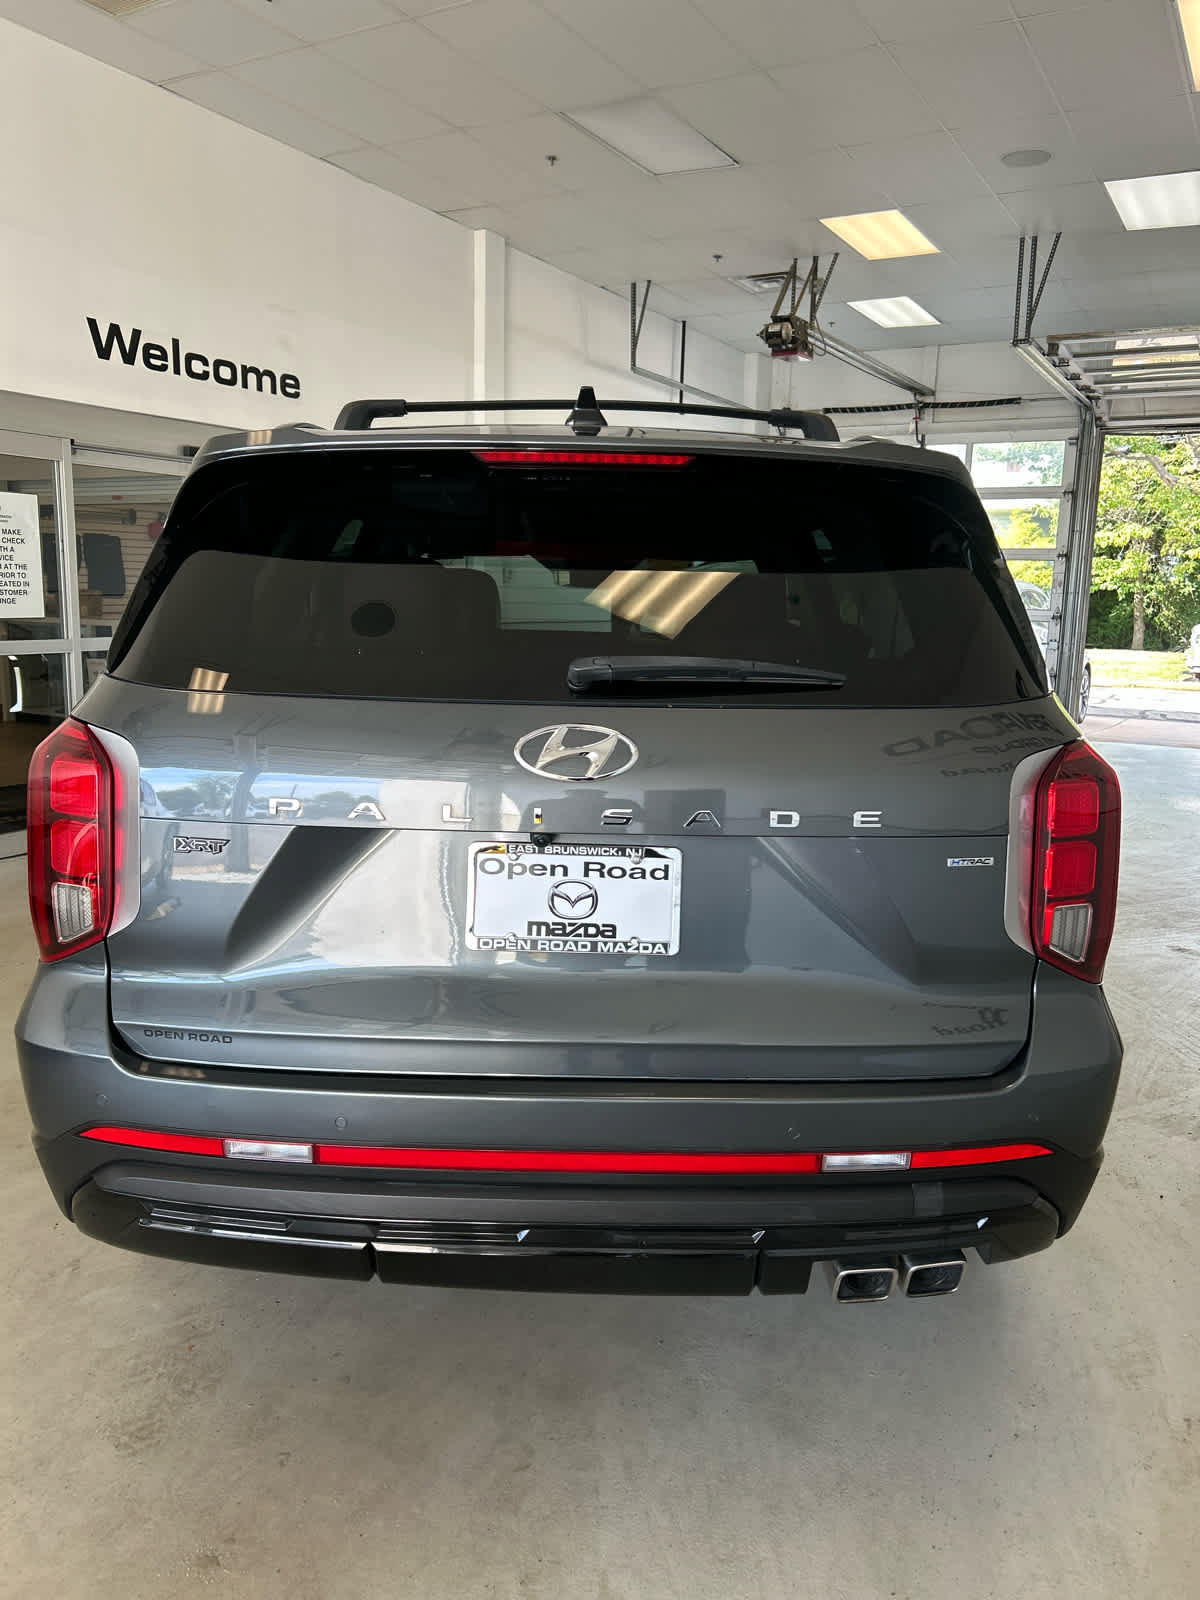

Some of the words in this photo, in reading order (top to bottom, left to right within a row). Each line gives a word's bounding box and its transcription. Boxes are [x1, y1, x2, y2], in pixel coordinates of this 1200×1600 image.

[86, 316, 301, 399] Welcome
[1, 528, 22, 536] MAKE
[1, 536, 26, 545] CHECK
[14, 563, 28, 571] THE
[23, 580, 30, 588] IN
[268, 797, 883, 828] PALISADE
[173, 836, 231, 855] XRT
[508, 845, 539, 854] EAST
[544, 846, 623, 856] BRUNSWICK,
[625, 847, 643, 857] NJ
[479, 857, 569, 880] Open
[583, 861, 670, 881] Road
[949, 857, 993, 866] HTRAC
[527, 921, 617, 939] mazda
[479, 938, 531, 951] OPEN
[537, 939, 591, 952] ROAD
[597, 941, 667, 954] MAZDA
[143, 1029, 184, 1040] OPEN
[188, 1033, 233, 1044] ROAD
